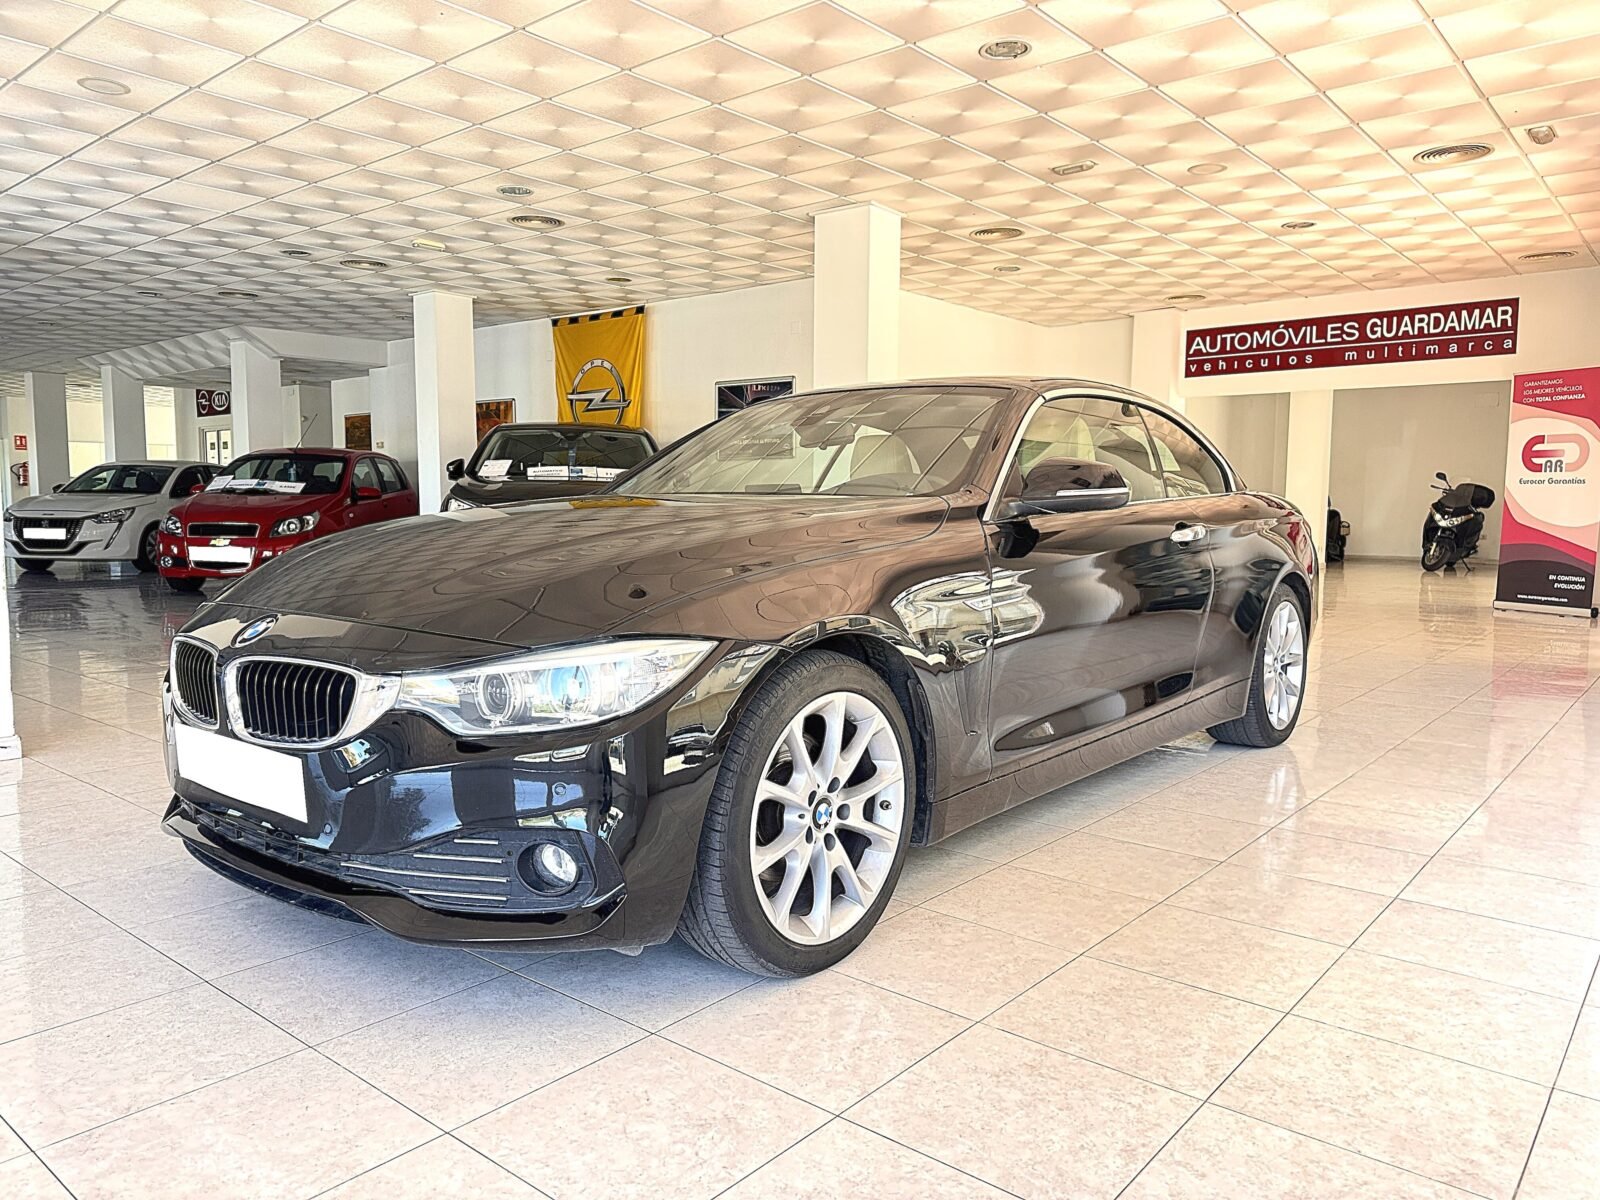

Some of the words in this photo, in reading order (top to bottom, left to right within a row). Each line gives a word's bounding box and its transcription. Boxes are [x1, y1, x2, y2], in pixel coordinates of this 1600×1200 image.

[1188, 321, 1359, 355] AUTOMÓVILES
[1366, 305, 1513, 339] GUARDAMAR
[1344, 338, 1513, 361] multimarca
[580, 360, 614, 374] OPEL
[1524, 379, 1563, 387] GARANTIZAMOS
[1533, 387, 1554, 395] MEJORES
[214, 394, 227, 406] KIA
[1553, 393, 1586, 401] CONFIANZA
[1519, 477, 1546, 485] Eurocar
[1547, 477, 1586, 485] Garantías
[1557, 574, 1585, 582] CONTINUA
[1554, 582, 1585, 590] EVOLUCIÓN
